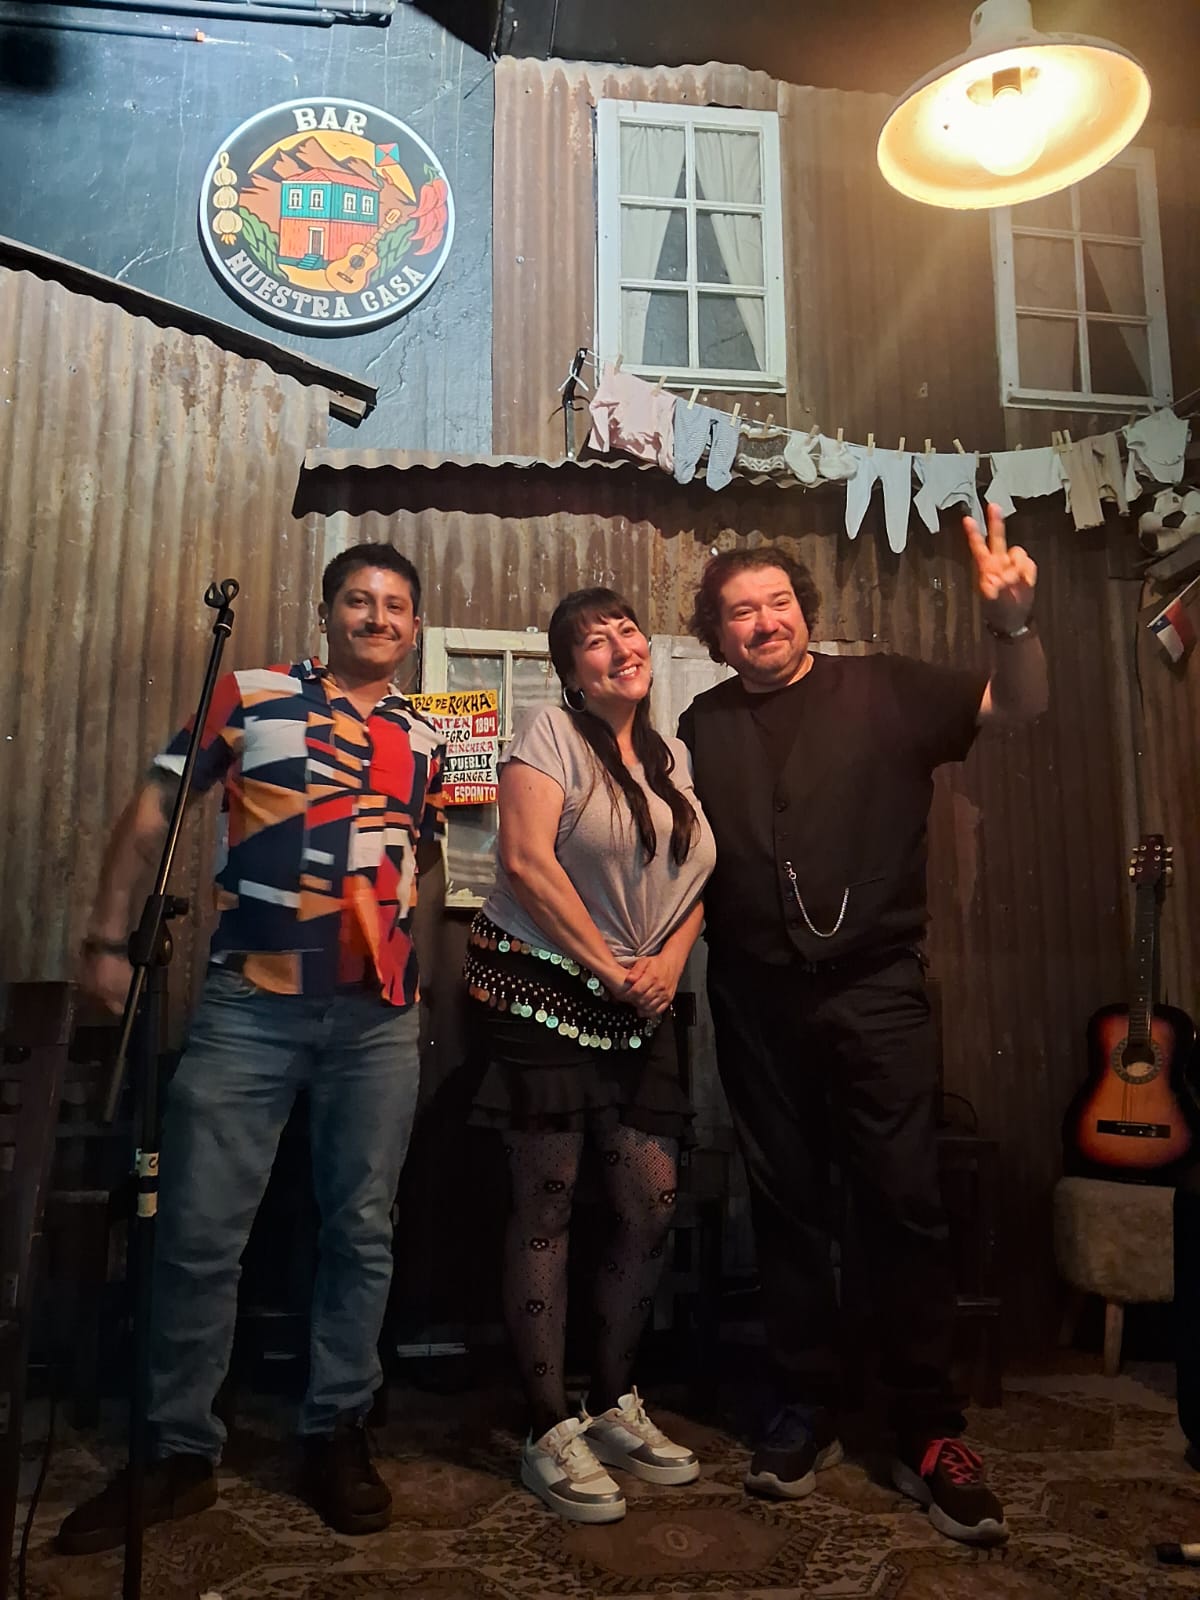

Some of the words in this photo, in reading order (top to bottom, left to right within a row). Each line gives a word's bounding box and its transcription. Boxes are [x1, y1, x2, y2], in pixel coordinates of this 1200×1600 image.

[292, 106, 368, 136] BAR
[225, 249, 352, 318] NUESTRA
[360, 265, 426, 312] CASA
[412, 695, 434, 711] BLO
[435, 698, 448, 709] DE
[448, 692, 492, 715] ROKHA
[431, 717, 471, 730] NTEN
[440, 729, 471, 743] EGRO
[447, 740, 495, 755] RINCHERA
[450, 754, 488, 771] PUEBLO
[453, 771, 493, 783] SANGRE
[454, 785, 497, 803] ESPANTO
